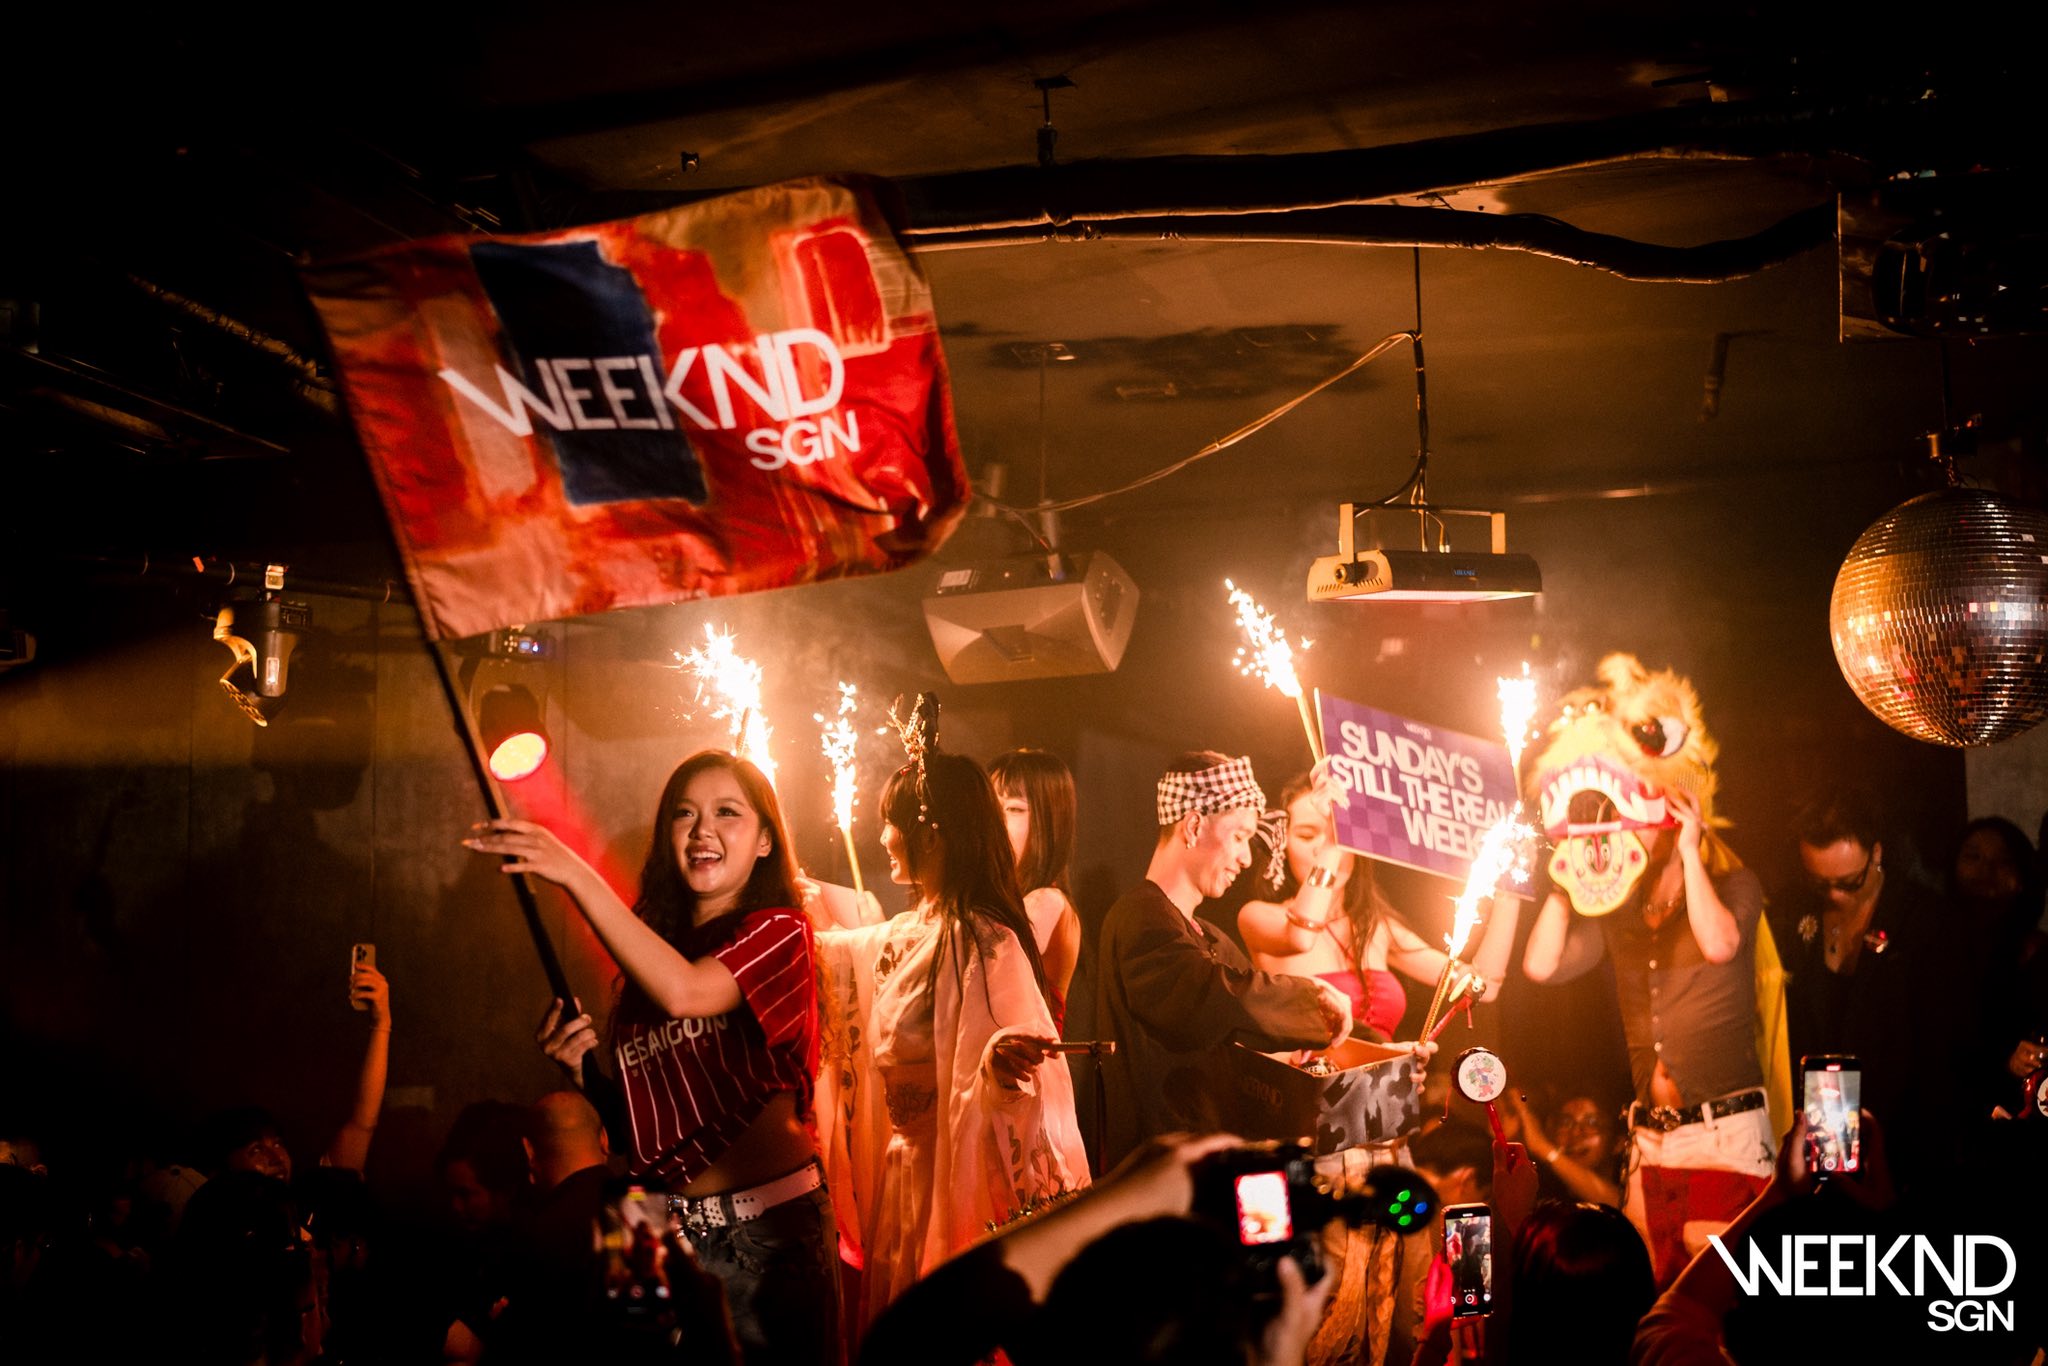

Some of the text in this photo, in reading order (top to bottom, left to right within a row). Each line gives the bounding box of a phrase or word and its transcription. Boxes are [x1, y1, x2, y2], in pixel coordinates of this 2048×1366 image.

[438, 328, 845, 437] WEEKND
[745, 411, 860, 471] SGN
[1330, 754, 1403, 804] STILL
[1399, 774, 1454, 820] THE
[1340, 720, 1484, 793] SUNDAY'S
